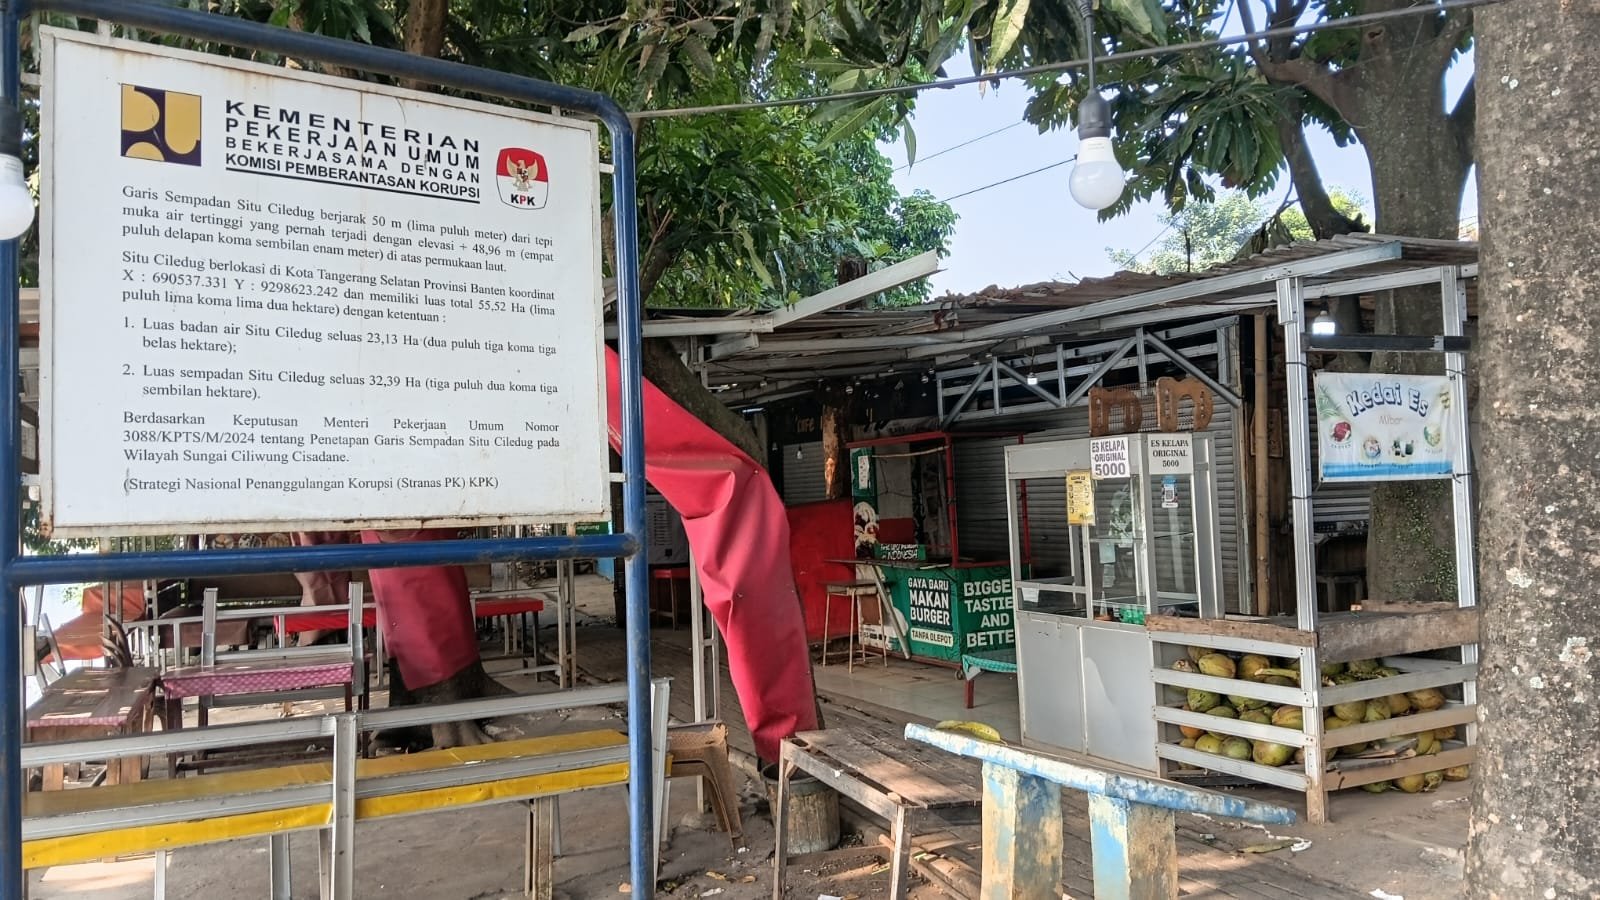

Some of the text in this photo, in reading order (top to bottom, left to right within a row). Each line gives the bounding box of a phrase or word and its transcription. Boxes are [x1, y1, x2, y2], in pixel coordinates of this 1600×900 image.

[226, 99, 479, 153] KEMENTERIAN
[226, 118, 479, 170] PEKERJAAN UMUM
[226, 136, 479, 184] BEKERJASAMA DENGAN
[225, 153, 480, 199] KOMISI PEMBERANTASAN KORUPSI
[510, 194, 535, 206] KPK
[122, 186, 552, 248] Garis Sempadan Situ Ciledug berjarak 50 m (lima puluh meter) dari tepi
[123, 206, 159, 218] muka
[166, 210, 184, 221] air
[190, 212, 242, 230] tertinggi
[250, 221, 279, 234] yang
[286, 225, 325, 236] pernah
[331, 228, 366, 242] terjadi
[373, 232, 412, 247] dengan
[418, 237, 454, 250] elevasi
[472, 243, 501, 256] 48,96
[506, 249, 515, 257] m
[520, 249, 554, 263] (empat
[122, 224, 506, 272] puluh delapan koma sembilan enam meter) di atas permukaan laut.
[122, 251, 555, 300] Situ Ciledug berlokasi di Kota Tangerang Selatan Provinsi Banten koordinat
[122, 269, 555, 316] X 690537.331 Y 9298623.242 dan memiliki luas total 55,52 Ha (lima
[122, 288, 439, 322] puluh lima koma lima dua hektare) dengan ketentuan
[124, 316, 556, 356] 1. Luas badan air Situ Ciledug seluas 23,13 Ha (dua puluh tiga koma tiga
[143, 336, 236, 354] belas hektare);
[122, 363, 558, 395] 2. Luas sempadan Situ Ciledug seluas 32,39 Ha (tiga puluh dua koma tiga
[142, 384, 260, 400] sembilan hektare).
[1346, 382, 1428, 417] Kedai Es
[124, 411, 559, 432] Berdasarkan Keputusan Menteri Pekerjaan Umum Nomor
[123, 430, 560, 450] 3088/KPTS/M/2024 tentang Penetapan Garis Sempadan Situ Ciledug pada
[1092, 440, 1125, 452] ES KELAPA
[123, 449, 349, 464] Wilayah Sungai Ciliwung Cisadane.
[1095, 453, 1125, 462] ORIGINAL
[1095, 463, 1125, 476] 5000
[124, 477, 498, 495] (Strategi Nasional Penanggulangan Korupsi (Stranas PK) KPK)
[908, 578, 927, 589] GAYA
[964, 579, 1011, 596] BIGGE
[910, 590, 949, 609] MAKAN
[964, 597, 1013, 613] TASTIE
[910, 607, 950, 625] BURGER
[981, 613, 1009, 628] AND
[912, 630, 929, 640] TANPA
[967, 629, 1014, 647] BETTE
